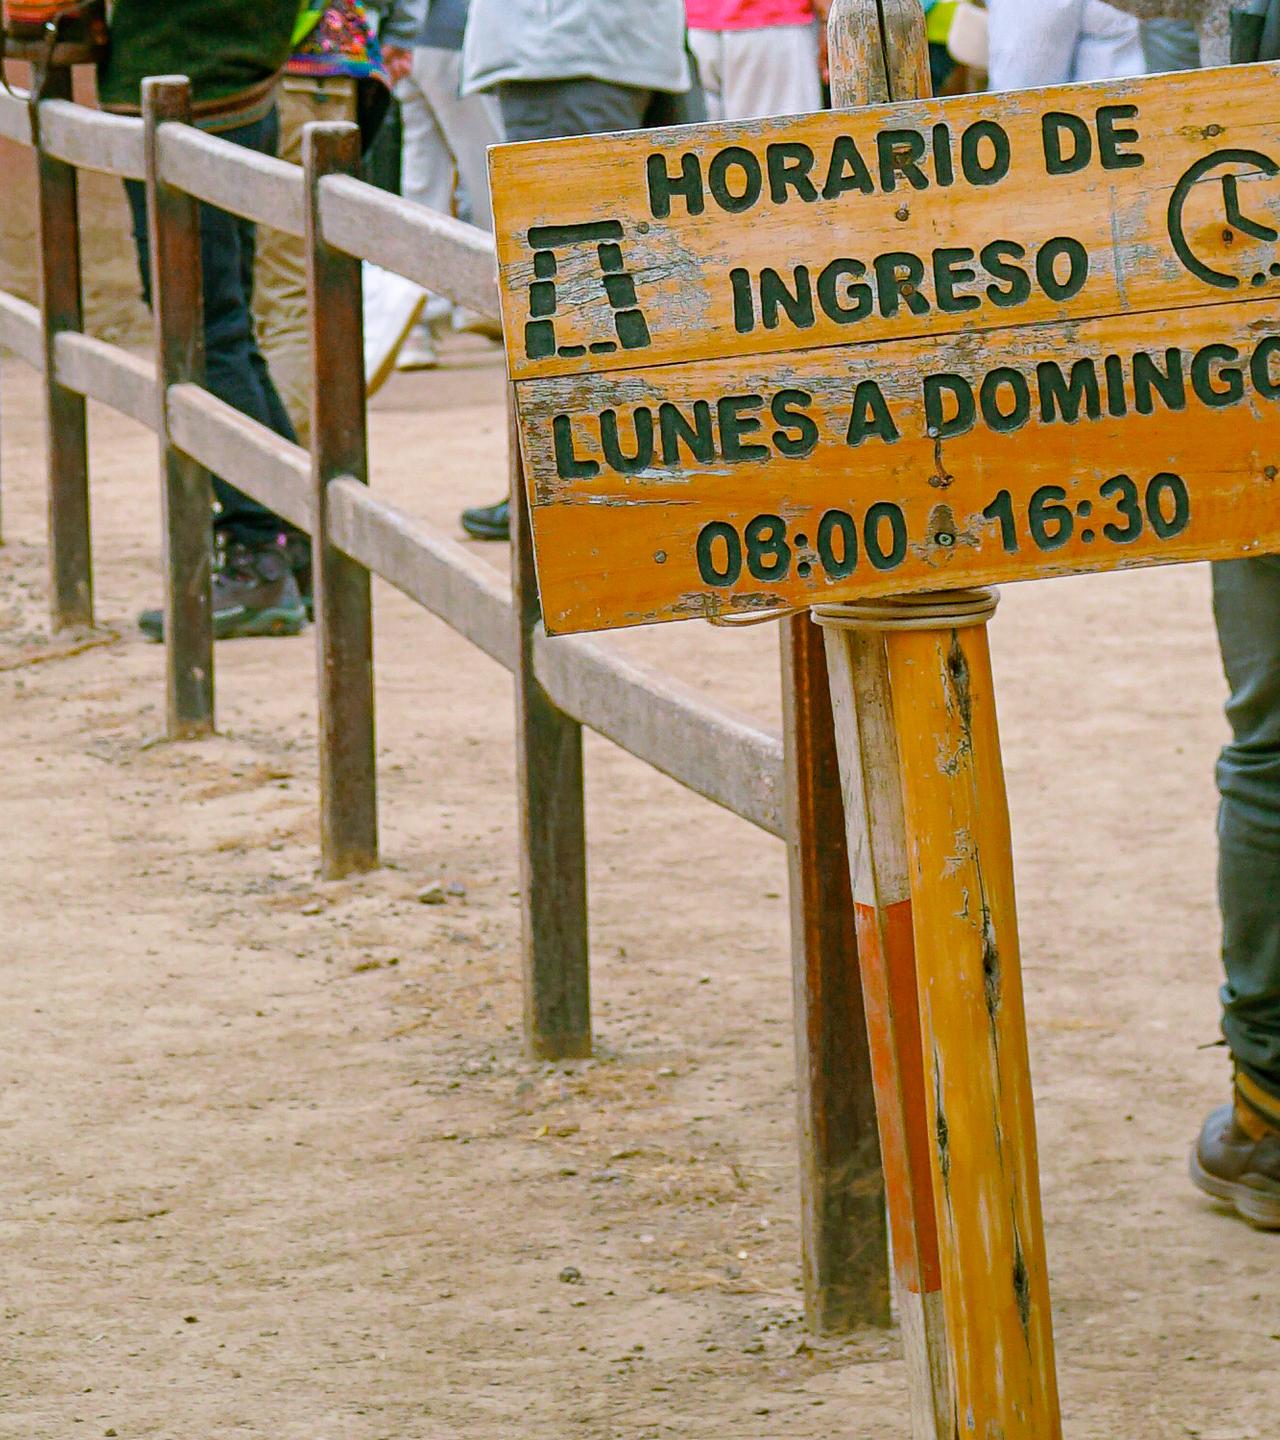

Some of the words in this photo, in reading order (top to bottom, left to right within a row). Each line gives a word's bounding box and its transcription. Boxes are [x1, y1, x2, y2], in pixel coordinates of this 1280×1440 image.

[645, 119, 1011, 219] HORARIO
[1042, 104, 1145, 176] DE
[731, 236, 1088, 333] INGRESO
[552, 388, 818, 479] LUNES
[846, 380, 899, 447] A
[695, 502, 908, 587] 08:00
[983, 472, 1190, 553] 16:30
